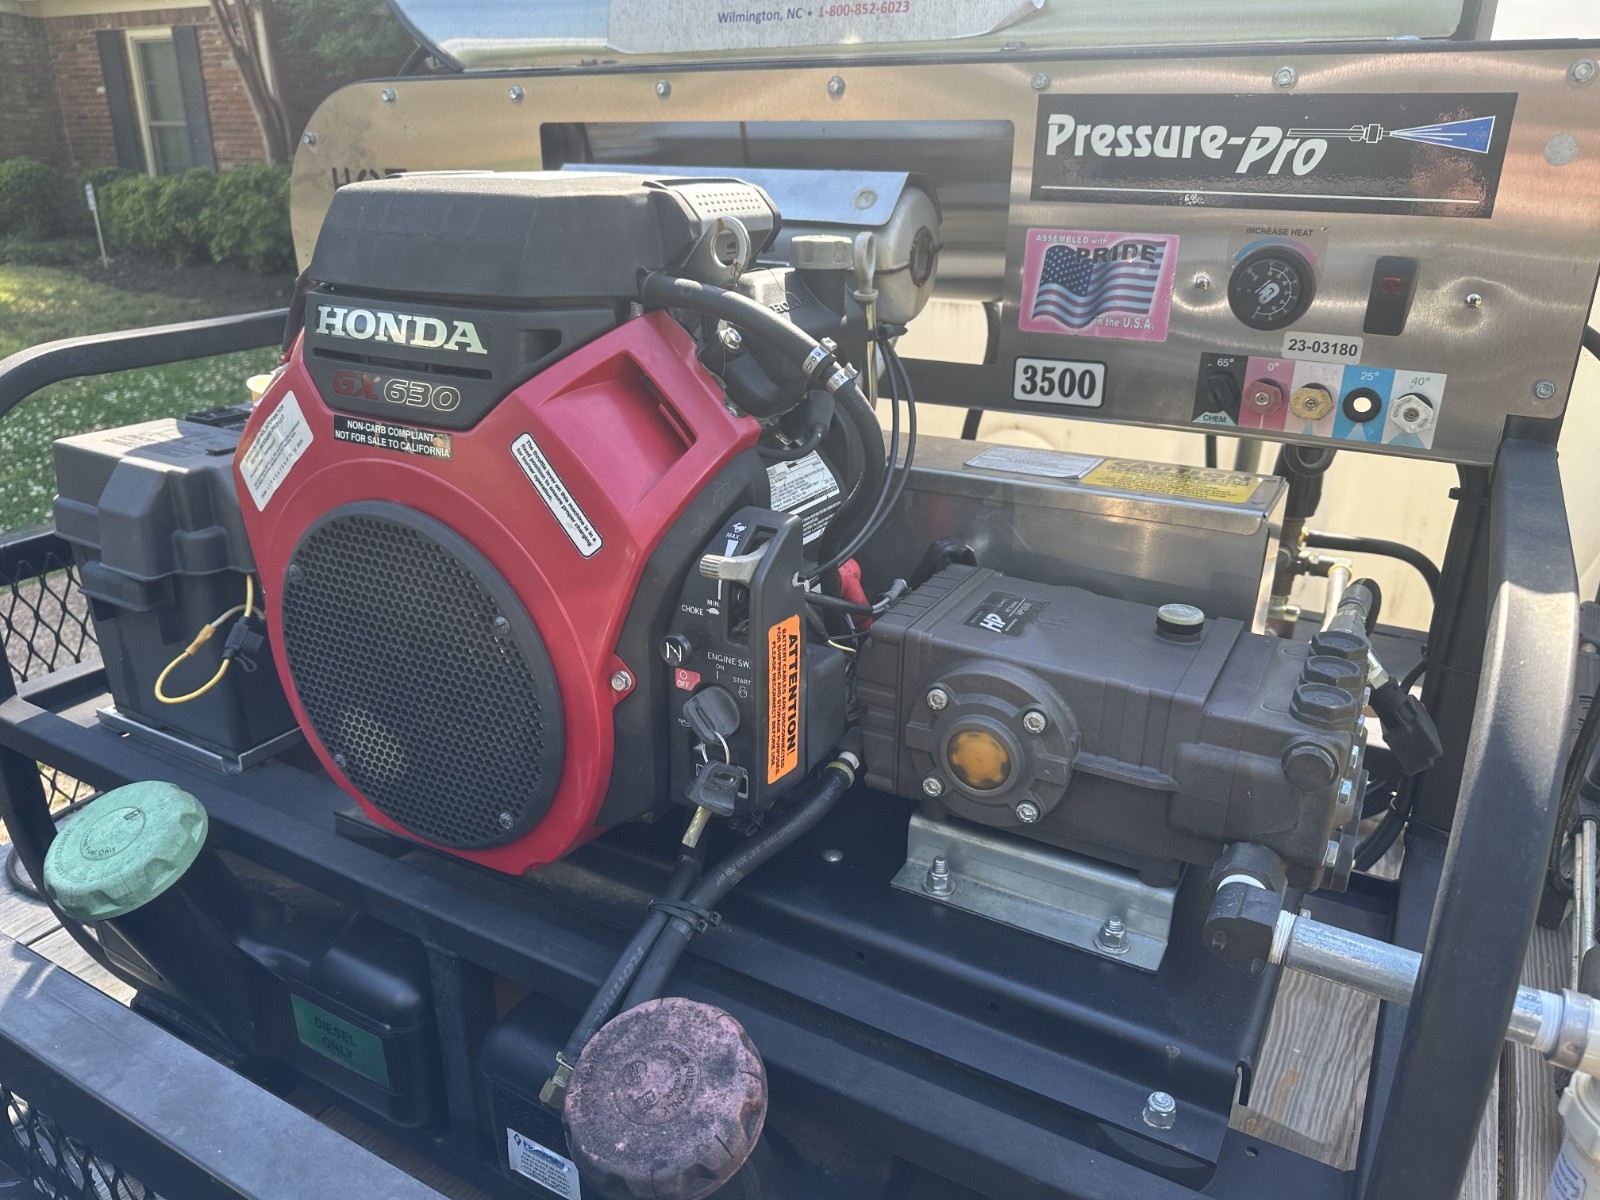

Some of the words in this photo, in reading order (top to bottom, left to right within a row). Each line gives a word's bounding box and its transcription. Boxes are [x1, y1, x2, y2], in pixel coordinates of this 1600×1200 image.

[718, 10, 784, 24] Wilmington,
[787, 7, 803, 20] NC
[818, 3, 909, 18] 1-800-852-6023
[1046, 114, 1328, 176] Pressure-Pro
[1036, 234, 1088, 245] ASSEMBLED
[1091, 237, 1108, 245] with
[1246, 227, 1289, 236] INCREASE
[1074, 243, 1157, 264] PRIDE
[316, 306, 487, 354] HONDA
[1105, 316, 1120, 327] the
[1122, 317, 1154, 330] U.S.A.
[1288, 338, 1358, 356] 23-03180
[1020, 364, 1096, 400] 3500
[1360, 372, 1380, 381] 25°
[1411, 377, 1430, 386] 40°
[333, 369, 381, 400] GX
[384, 378, 461, 411] 630
[1203, 414, 1227, 423] CHEM
[347, 420, 386, 434] NON-CARB
[388, 426, 434, 442] COMPLIANT
[335, 429, 349, 439] NOT
[351, 432, 366, 442] FOR
[367, 435, 387, 447] SALE
[388, 440, 399, 449] TO
[400, 441, 450, 458] CALIFORNIA
[515, 447, 524, 456] for
[521, 456, 536, 474] burner
[532, 474, 554, 502] operation.
[524, 439, 534, 450] The
[532, 450, 547, 470] throttle
[545, 469, 556, 483] lever
[554, 483, 561, 492] on
[559, 491, 569, 503] this
[567, 502, 585, 525] machine
[520, 443, 532, 457] fixed
[528, 457, 546, 479] position
[548, 486, 563, 505] ensure
[560, 504, 576, 523] proper
[573, 522, 592, 547] charging
[682, 604, 703, 615] CHOKE
[707, 599, 721, 607] MIN.
[980, 613, 1006, 633] HP
[707, 651, 736, 665] ENGINE
[738, 659, 751, 669] SW.
[677, 679, 690, 687] OFF
[732, 677, 751, 685] START
[787, 634, 798, 755] ATTENTION!
[725, 864, 738, 876] PSI
[314, 1016, 358, 1048] DIESEL
[322, 1036, 353, 1060] ONLY
